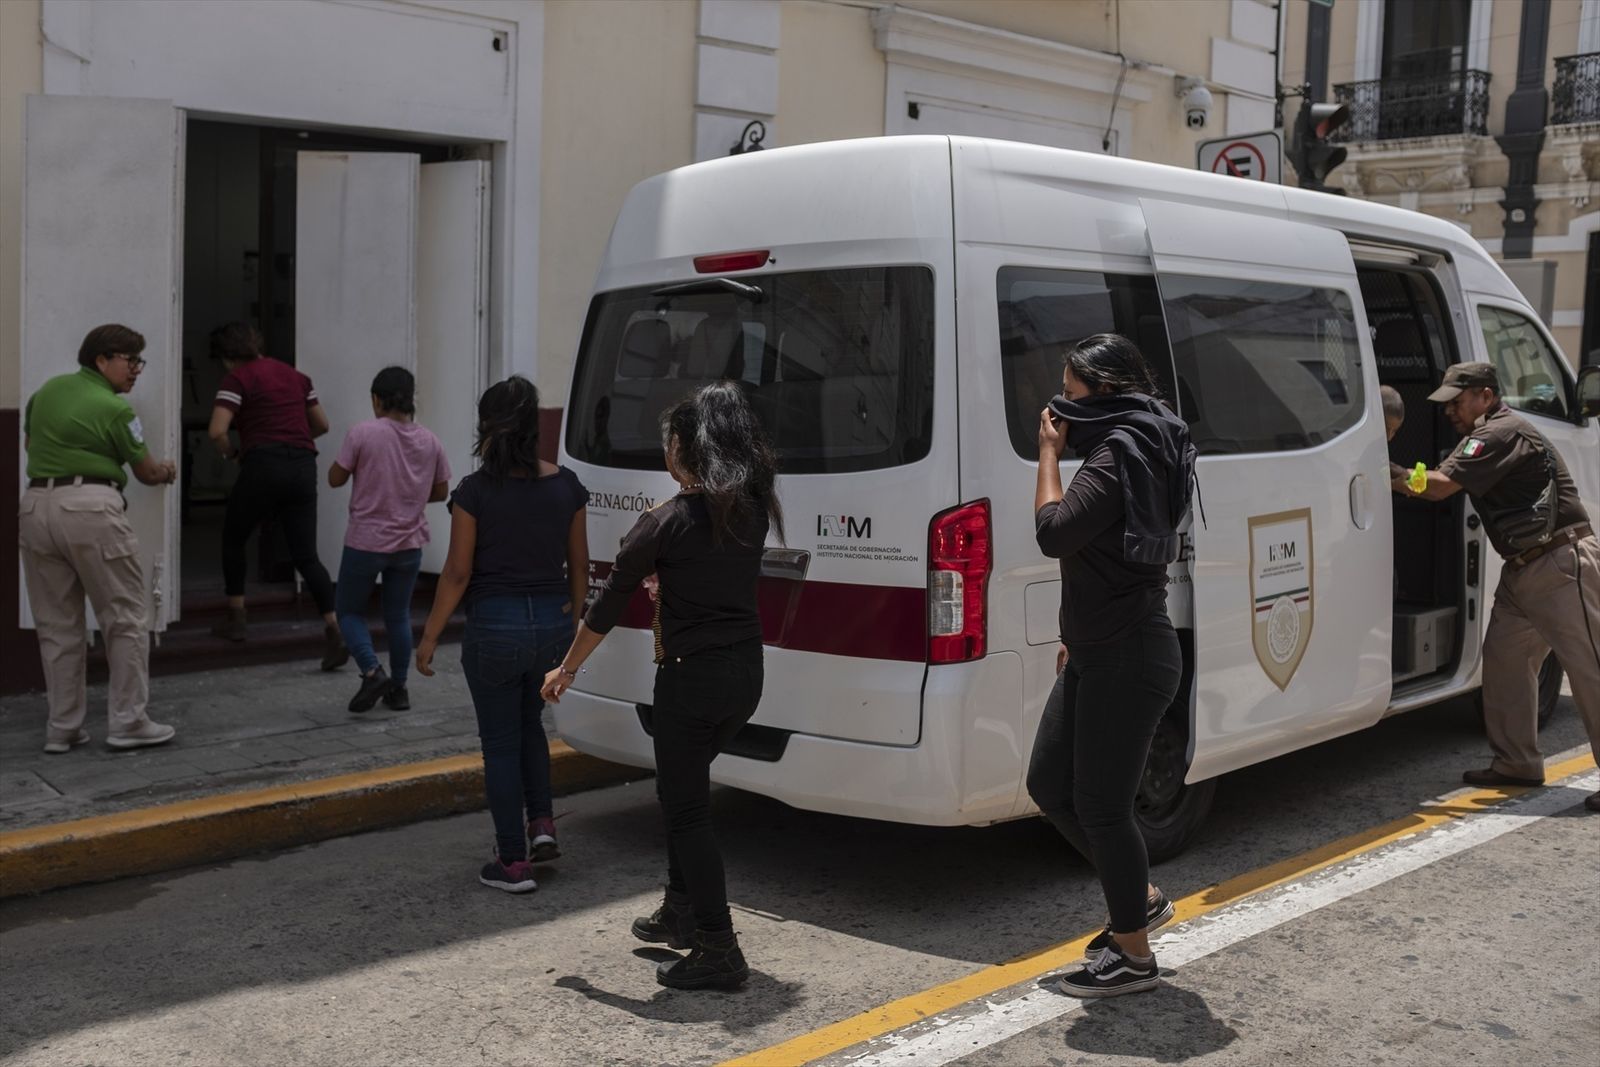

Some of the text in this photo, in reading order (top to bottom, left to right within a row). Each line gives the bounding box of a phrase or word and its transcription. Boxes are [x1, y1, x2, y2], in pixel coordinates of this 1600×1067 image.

[587, 492, 655, 512] ERNACIÓN
[816, 544, 849, 552] SECRETARÍA
[816, 551, 844, 559] INSTITUTO
[844, 552, 873, 560] NACIONAL
[883, 554, 919, 562] MIGRACIÓN
